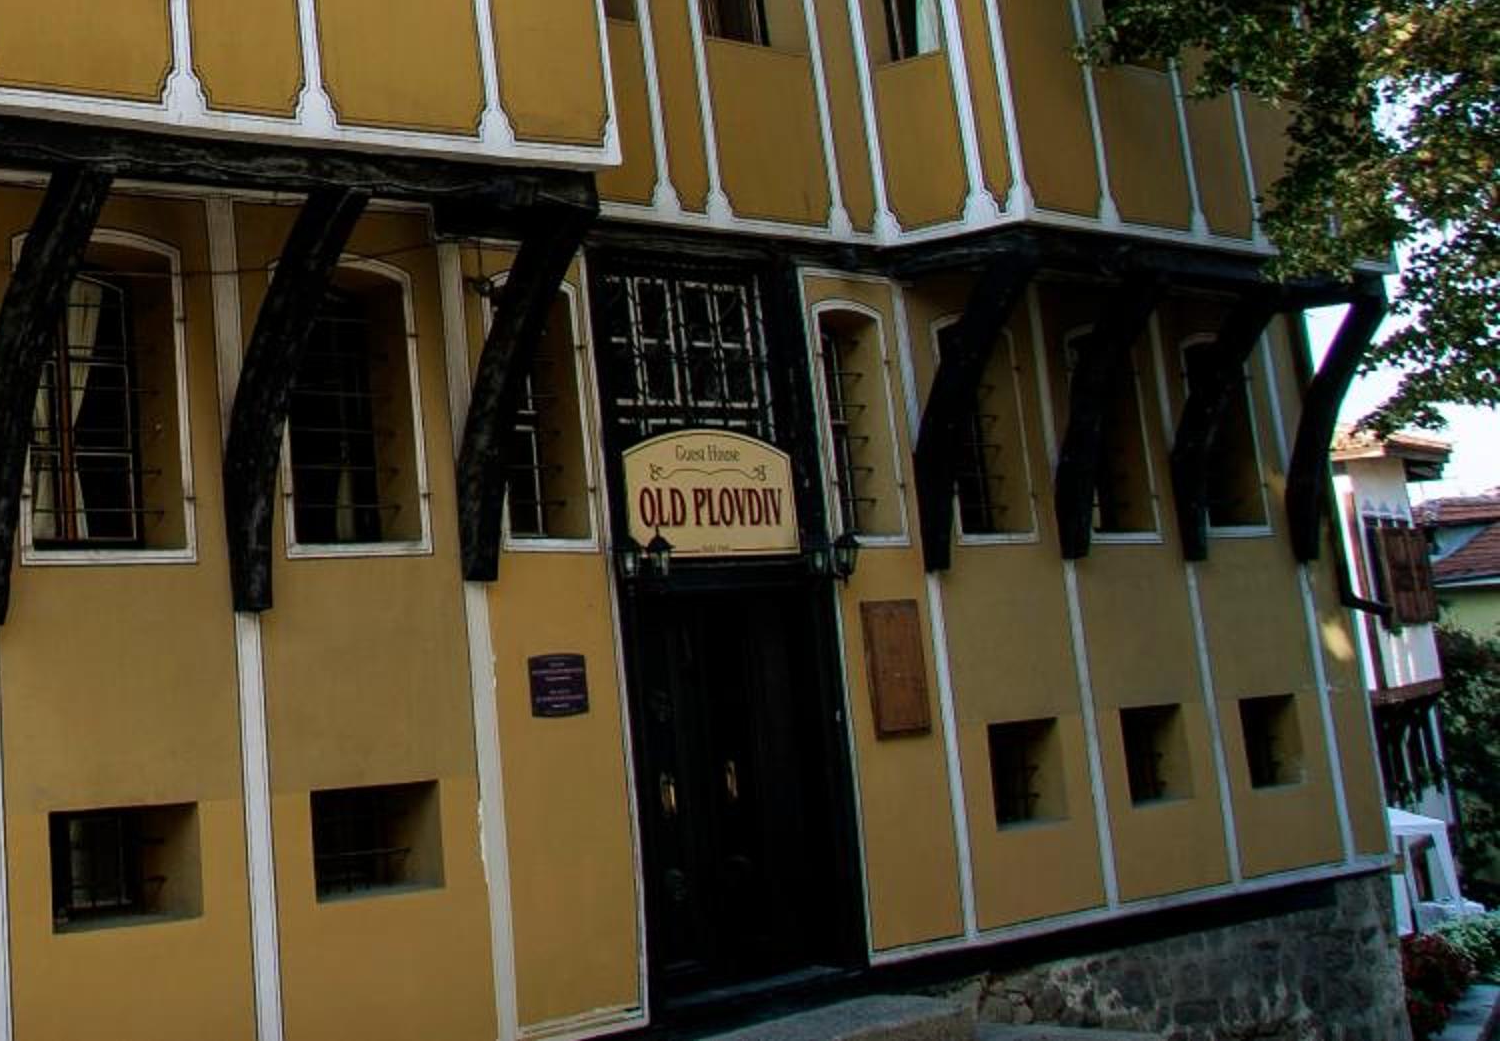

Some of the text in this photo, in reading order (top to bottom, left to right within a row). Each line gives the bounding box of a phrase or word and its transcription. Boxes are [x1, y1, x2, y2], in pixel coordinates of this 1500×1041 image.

[707, 444, 741, 462] House
[639, 487, 783, 528] OLD PLOVDIV
